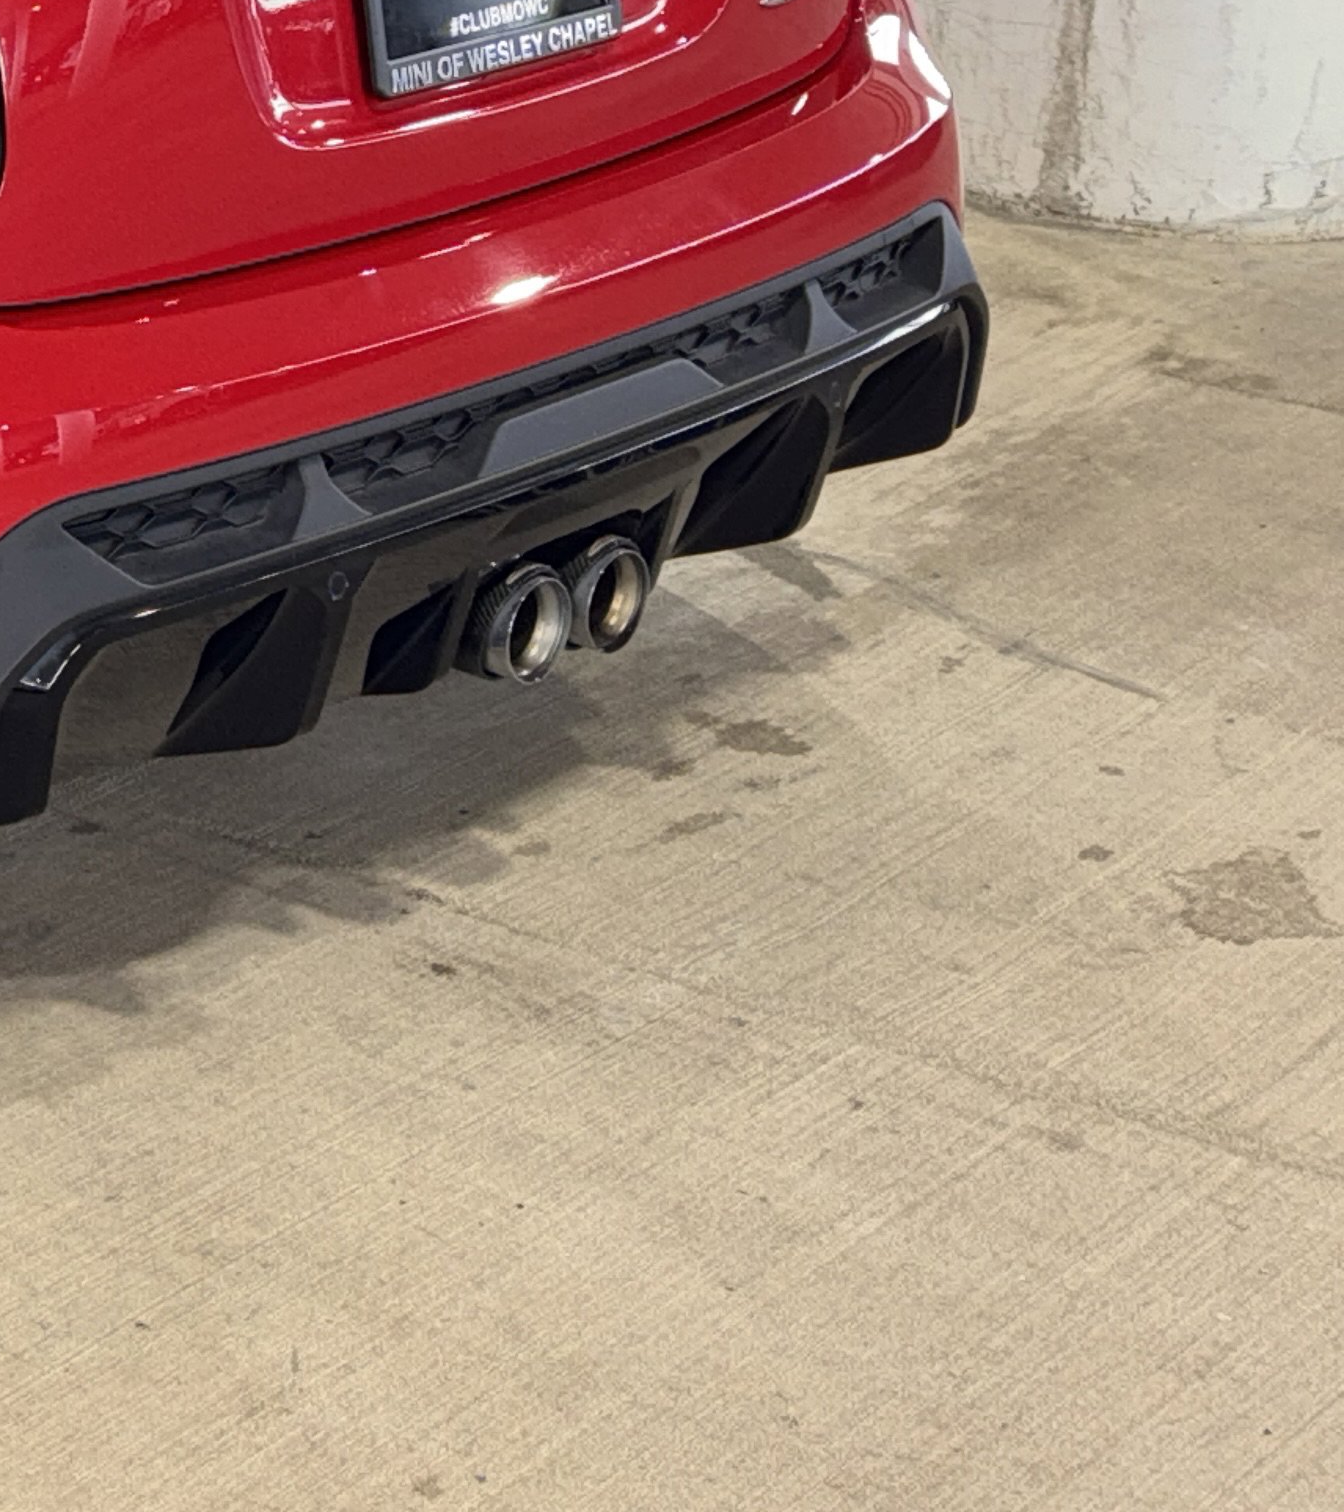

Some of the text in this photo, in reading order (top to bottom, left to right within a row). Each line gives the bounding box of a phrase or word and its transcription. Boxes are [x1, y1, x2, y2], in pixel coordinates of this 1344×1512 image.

[391, 12, 619, 94] MINI OF WESLEY CHAPEL
